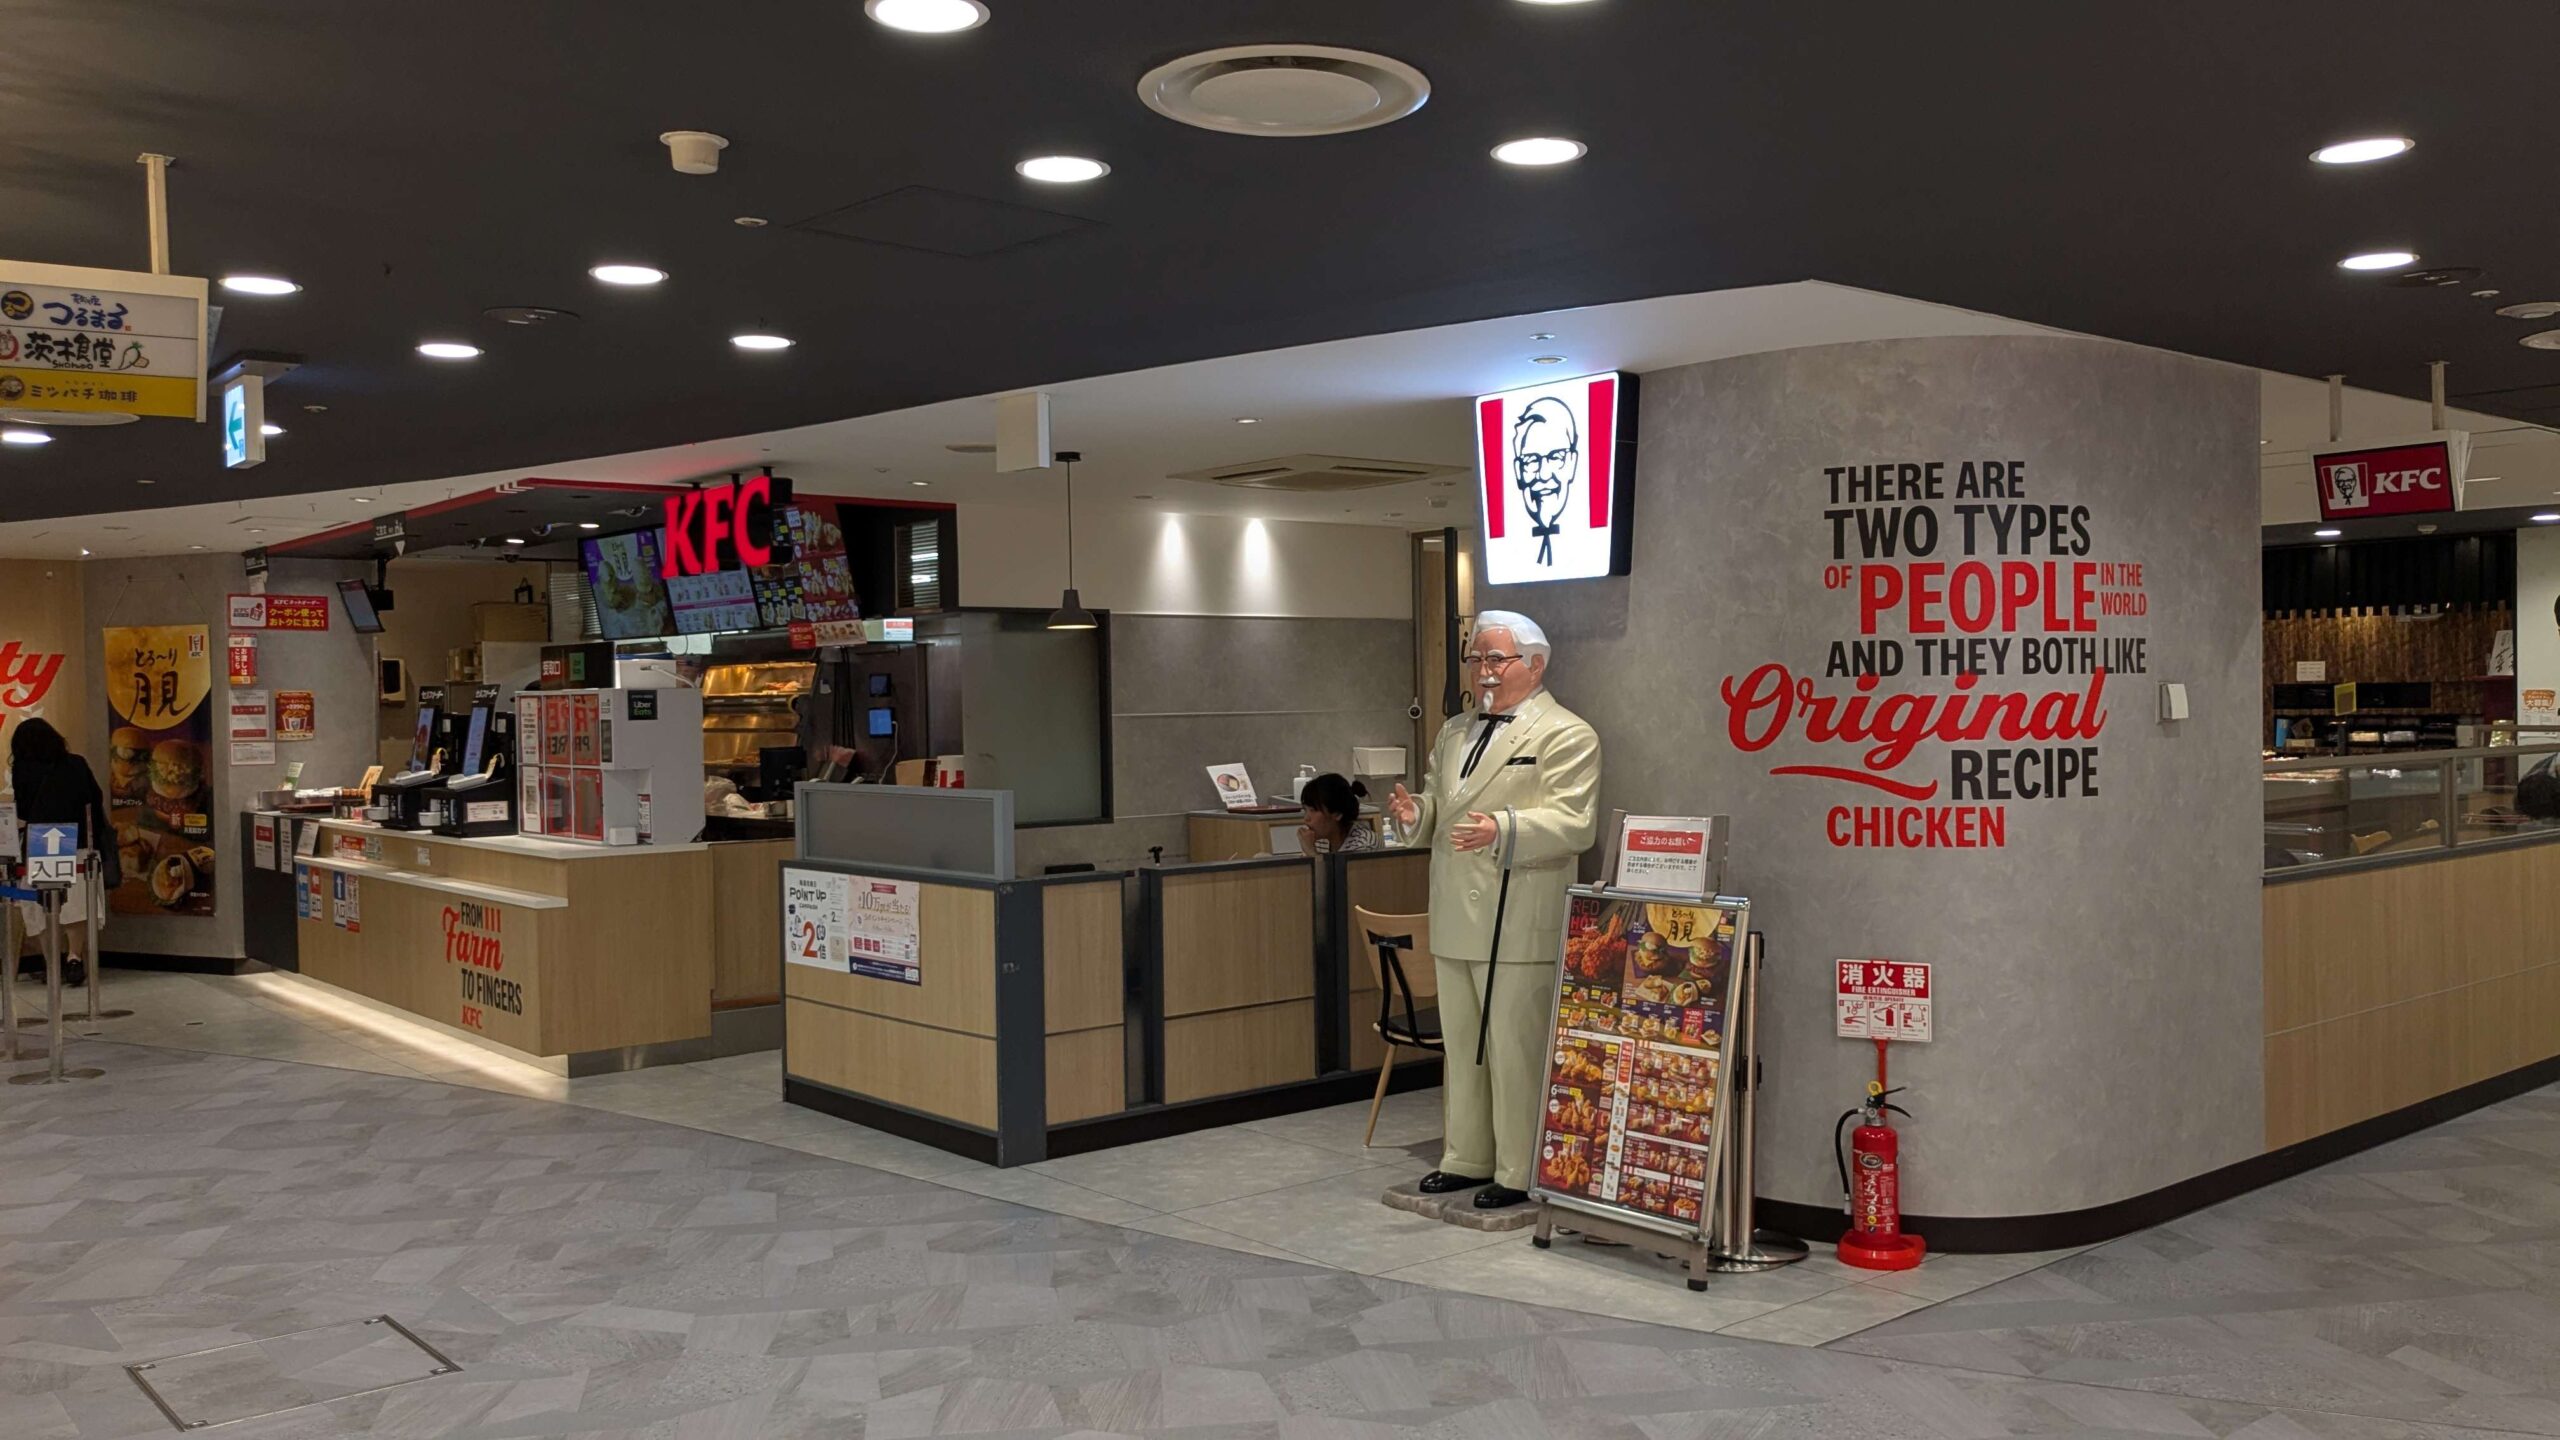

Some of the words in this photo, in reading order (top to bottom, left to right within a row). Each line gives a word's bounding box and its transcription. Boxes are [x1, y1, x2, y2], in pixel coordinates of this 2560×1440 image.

[42, 302, 128, 330] つるまる
[31, 385, 138, 402] ミツバチ珈琲
[1823, 462, 1945, 504] THERE
[1955, 461, 2026, 500] ARE
[2373, 467, 2442, 495] KFC
[661, 476, 771, 580] KFC
[1823, 506, 1939, 560] TWO
[1953, 504, 2091, 557] TYPES
[2100, 563, 2115, 586] IN
[2117, 563, 2143, 587] THE
[269, 607, 325, 618] クーポン使って
[1823, 564, 1853, 590] OF
[1860, 561, 2098, 635] PEOPLE
[2100, 591, 2147, 617] WORLD
[1825, 639, 1904, 678] AND
[1915, 638, 2012, 677] THEY
[2022, 637, 2096, 675] BOTH
[2103, 637, 2147, 674] LIKE
[128, 670, 191, 721] 月見
[633, 700, 653, 708] Uber
[1720, 663, 2109, 770] Original
[1950, 746, 2099, 801] RECIPE
[1826, 805, 2006, 848] CHICKEN
[31, 860, 74, 879] 入口
[460, 901, 484, 930] FROM
[441, 906, 504, 972] Farm
[1841, 963, 1926, 990] 消火器
[1851, 985, 1866, 994] FIRE
[1867, 986, 1917, 997] EXTINGUISHER
[461, 967, 475, 1001] TO
[476, 972, 522, 1016] FINGERS
[461, 1004, 483, 1029] KFC
